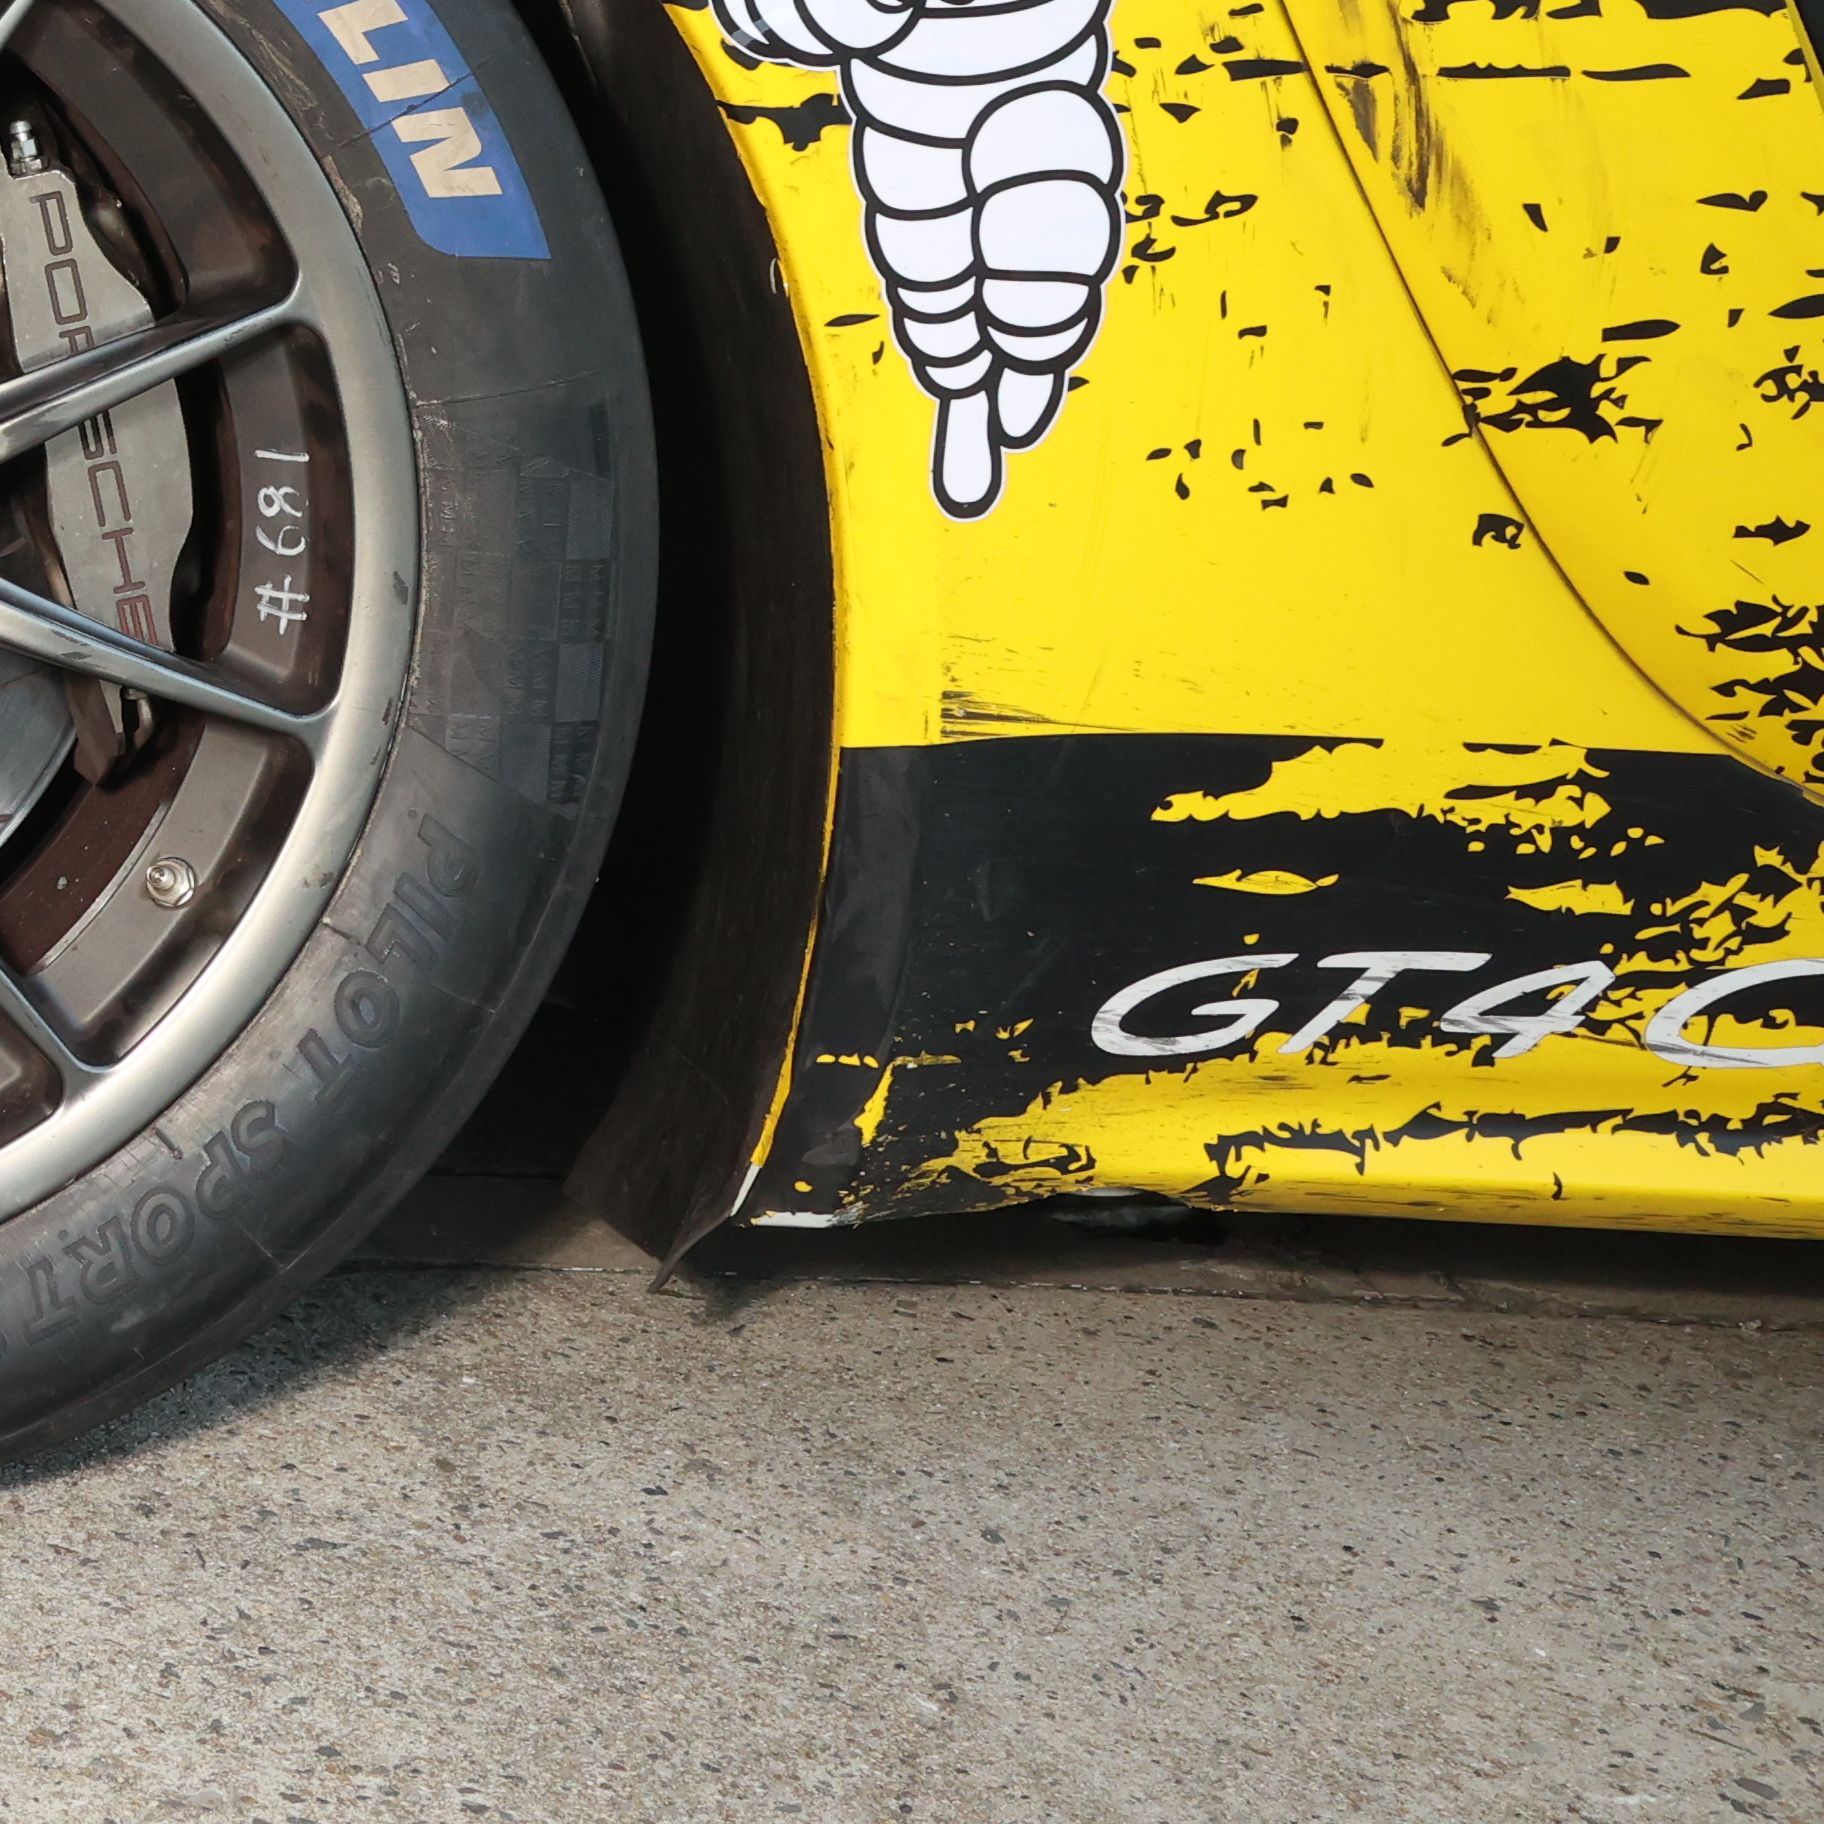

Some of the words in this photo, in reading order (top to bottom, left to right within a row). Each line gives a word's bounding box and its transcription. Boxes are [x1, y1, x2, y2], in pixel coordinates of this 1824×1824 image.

[254, 448, 311, 636] #681
[291, 814, 483, 1104] PILOT
[16, 1094, 298, 1336] SPORT
